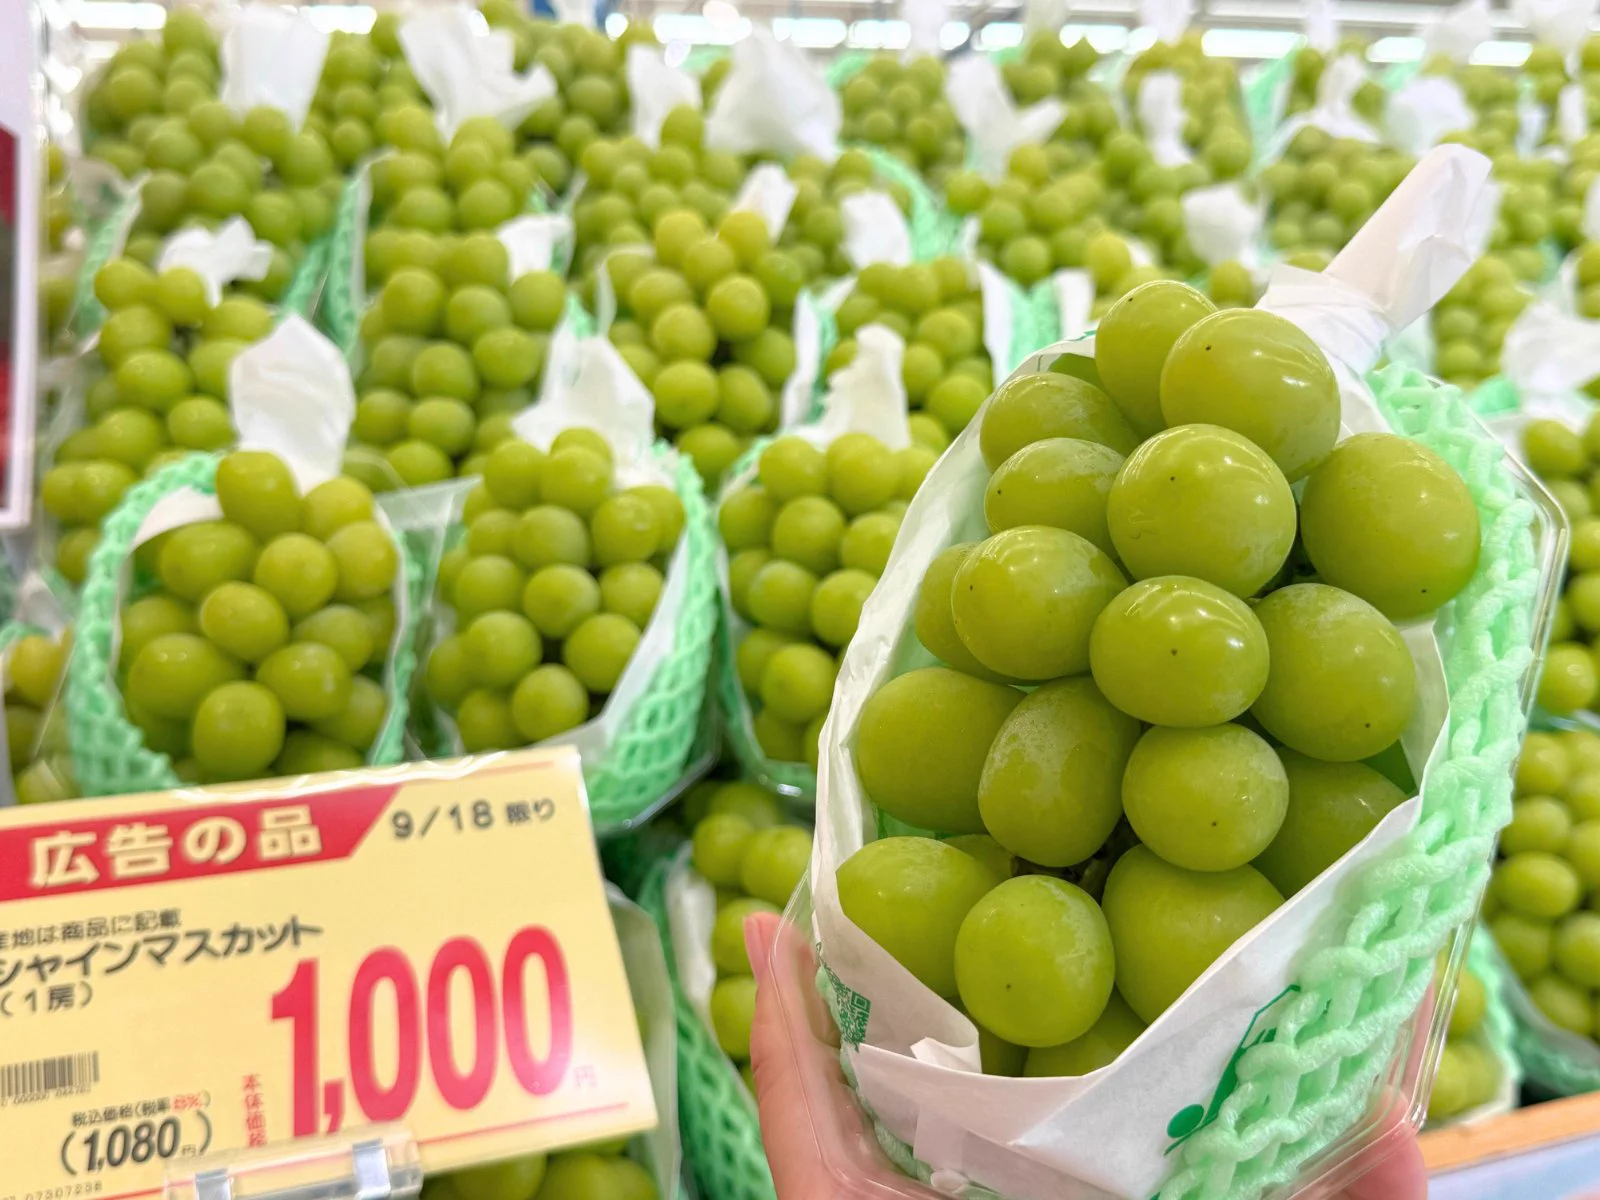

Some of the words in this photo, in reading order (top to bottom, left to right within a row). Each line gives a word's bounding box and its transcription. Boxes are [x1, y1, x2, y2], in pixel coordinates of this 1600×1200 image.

[30, 804, 323, 887] 広告の品
[391, 799, 494, 838] 9/18
[271, 924, 574, 1138] 1,000
